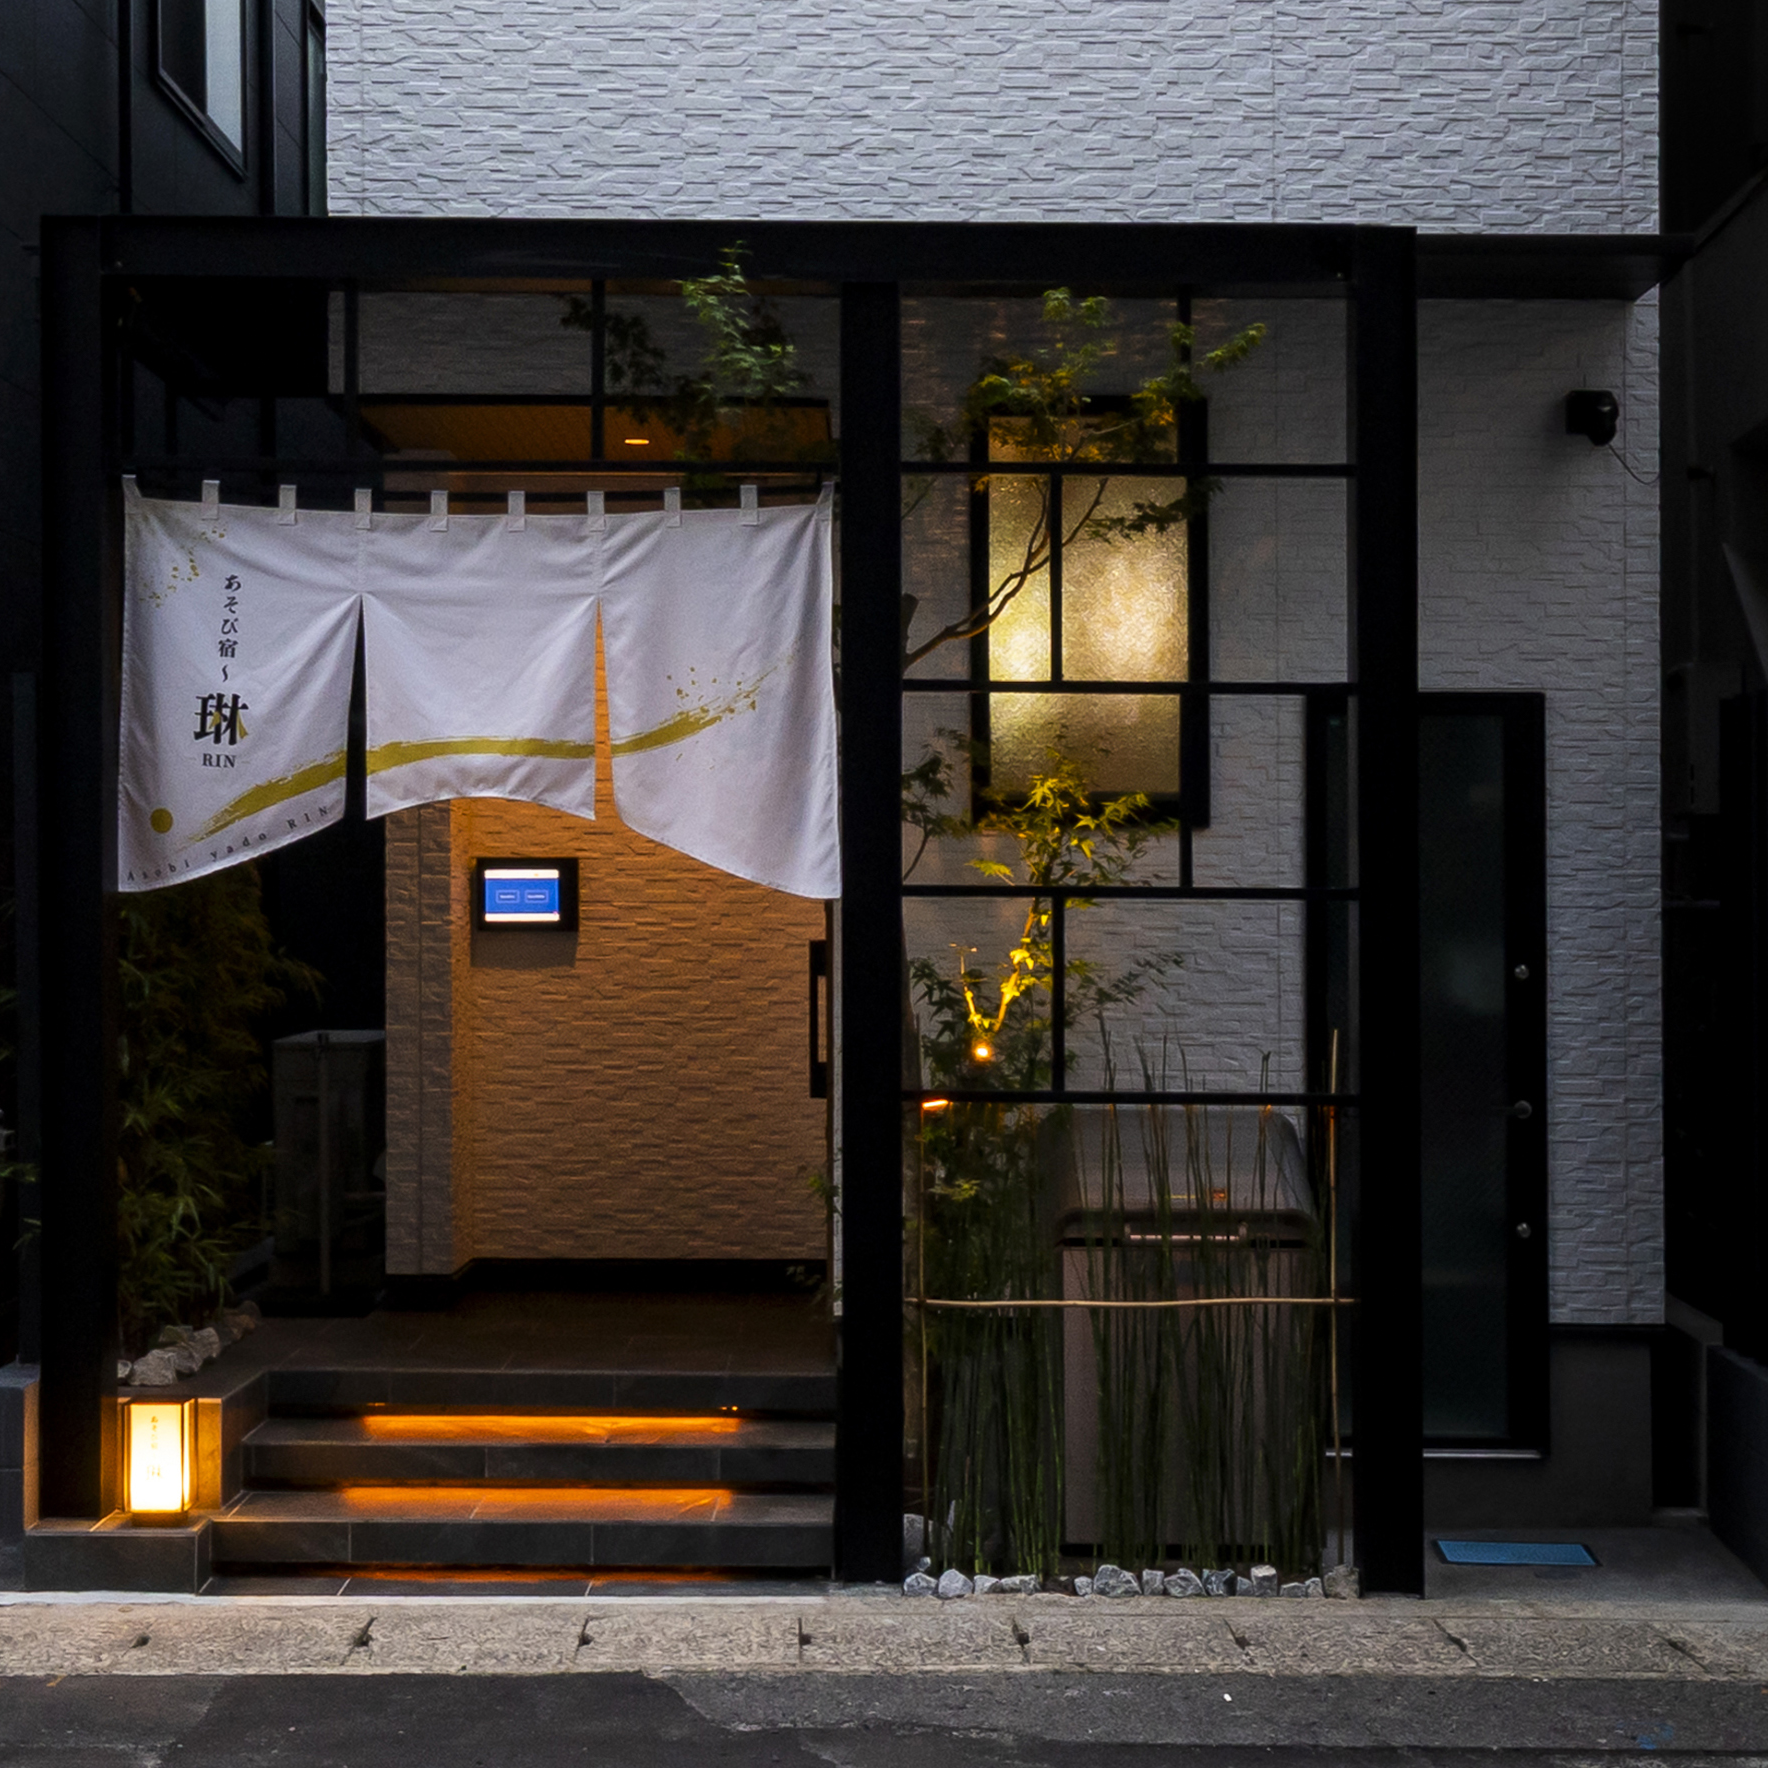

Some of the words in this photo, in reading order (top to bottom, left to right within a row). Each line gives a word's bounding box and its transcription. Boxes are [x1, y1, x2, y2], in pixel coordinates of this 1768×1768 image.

[193, 692, 249, 745] 琳
[201, 753, 236, 768] RIN
[209, 832, 267, 863] yado
[286, 805, 330, 829] RIN
